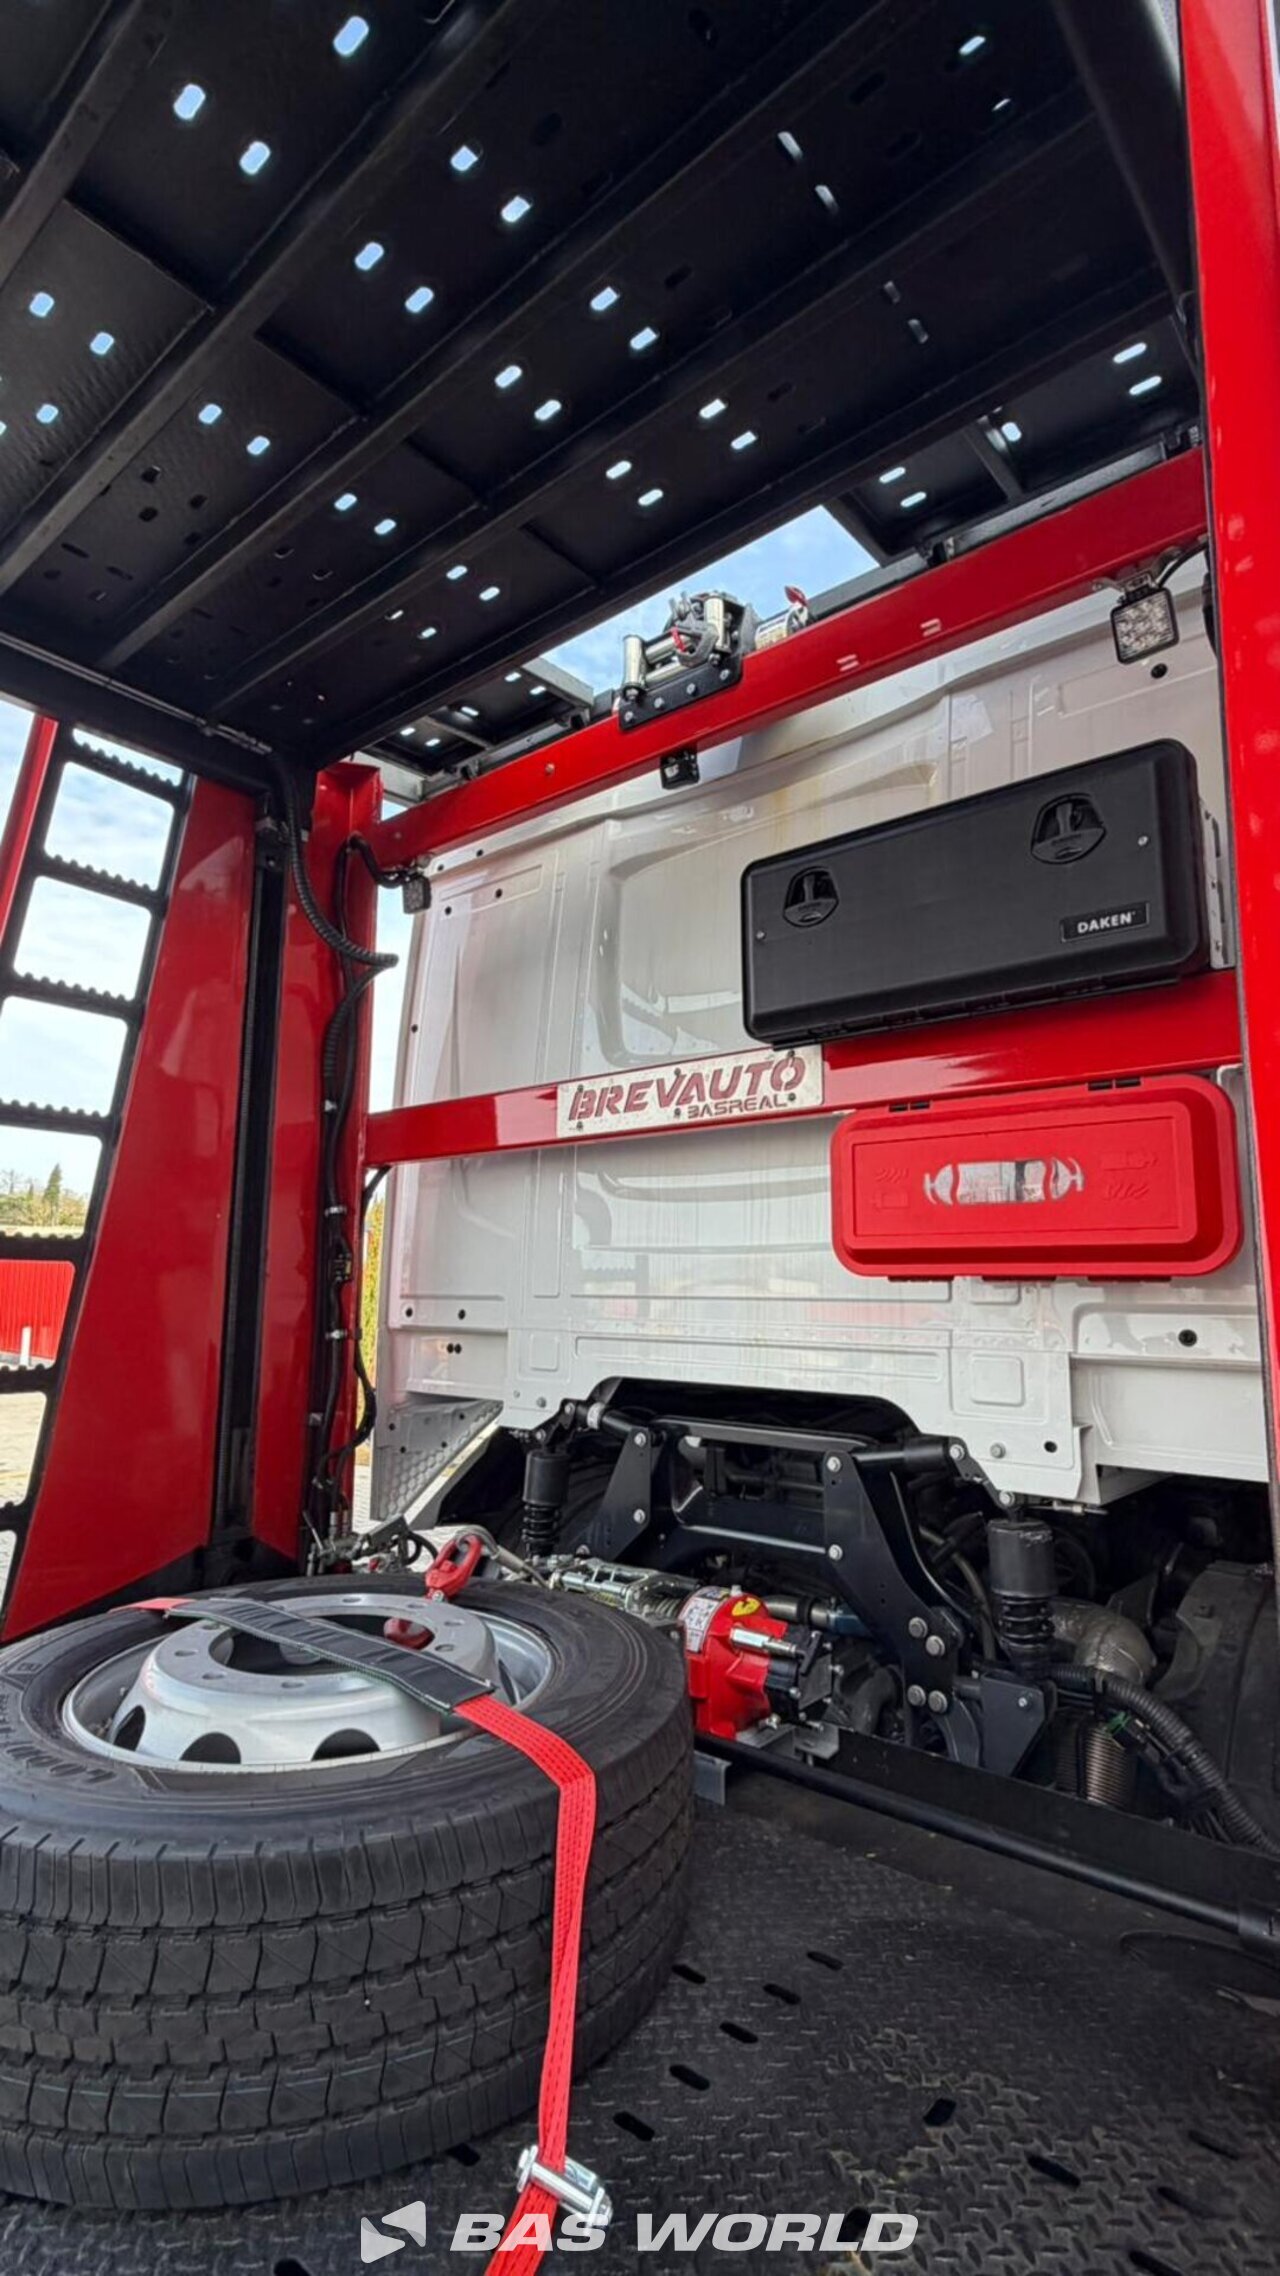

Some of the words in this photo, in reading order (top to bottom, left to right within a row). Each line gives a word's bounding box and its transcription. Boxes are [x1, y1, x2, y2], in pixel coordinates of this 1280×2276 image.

[1077, 911, 1132, 934] DAKEN
[568, 1056, 806, 1121] BREVAUTO
[687, 1093, 788, 1119] BASREAL
